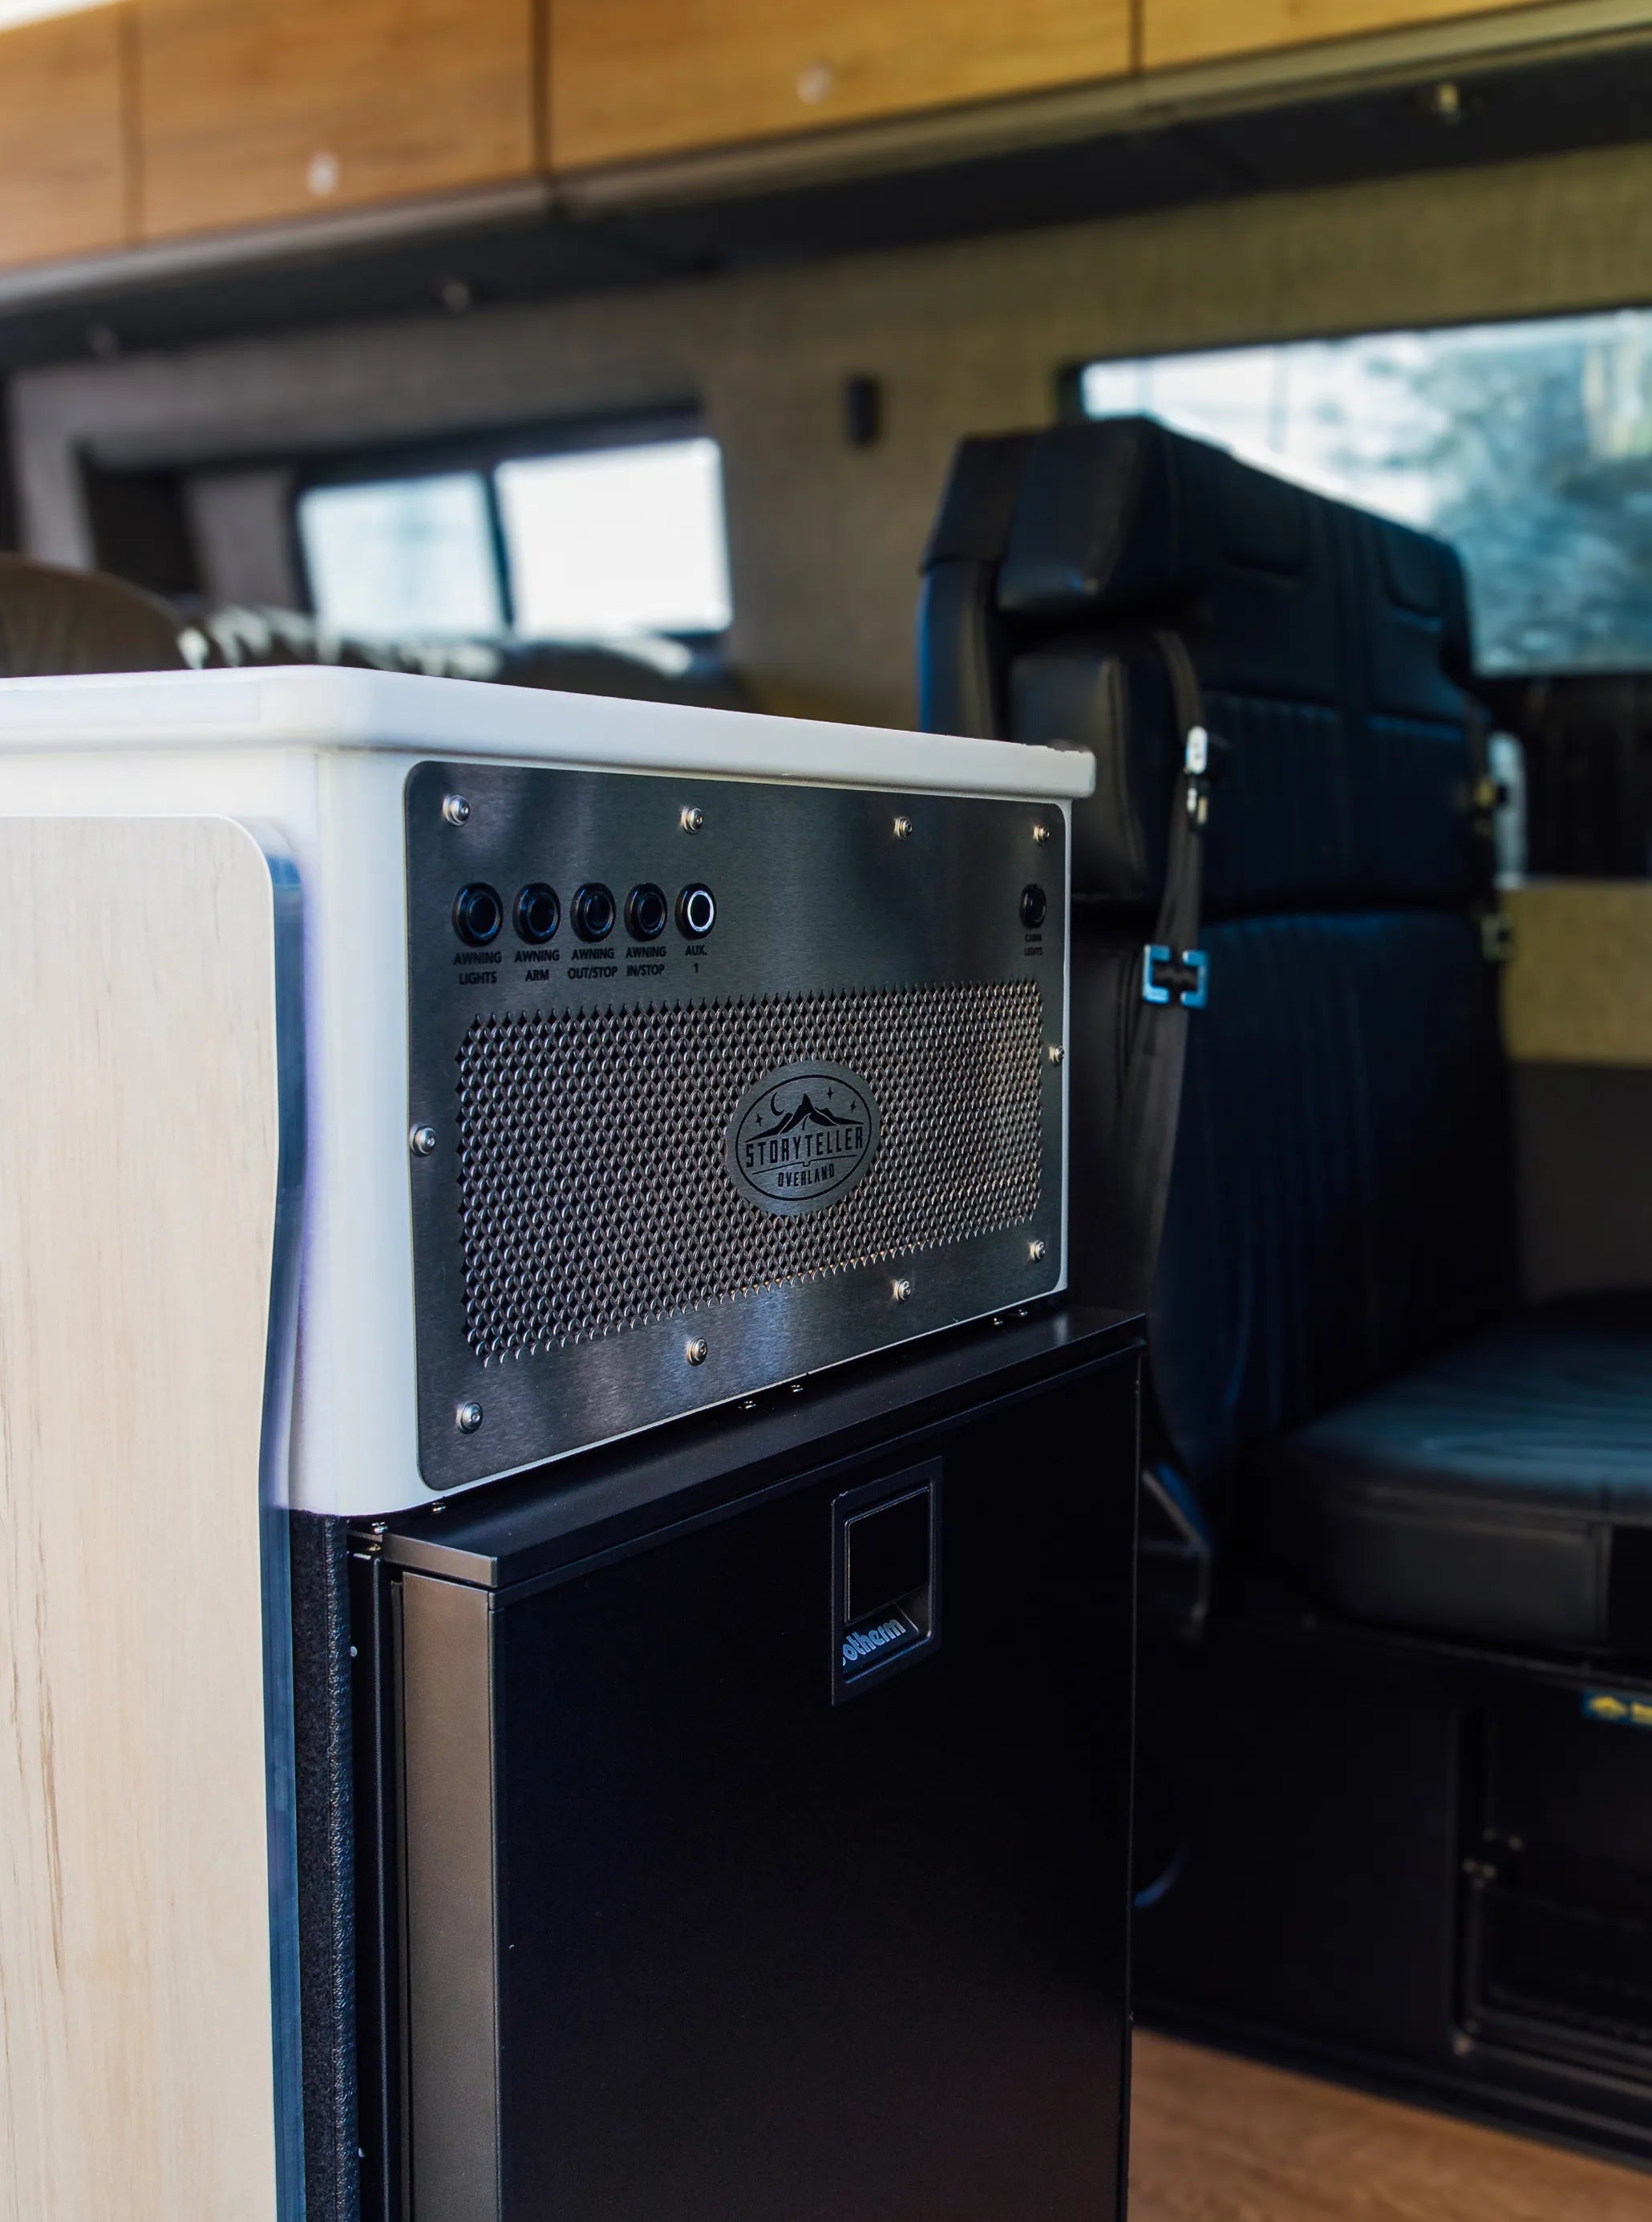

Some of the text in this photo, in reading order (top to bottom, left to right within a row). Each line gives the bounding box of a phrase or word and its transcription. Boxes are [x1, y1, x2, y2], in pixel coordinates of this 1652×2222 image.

[453, 951, 503, 965] AWNING
[514, 949, 561, 963] AWNING
[571, 947, 615, 961] AWNING
[626, 946, 667, 959] AWNING
[685, 945, 708, 957] AUX.
[524, 969, 550, 982] ARM
[567, 966, 618, 980] OUT/STOP
[626, 964, 666, 977] IN/STOP
[693, 963, 699, 974] 1
[459, 971, 498, 985] LIGHTS
[745, 1126, 864, 1168] STORYTELLER
[777, 1163, 835, 1187] OVERLAND
[842, 1619, 906, 1667] otherm
